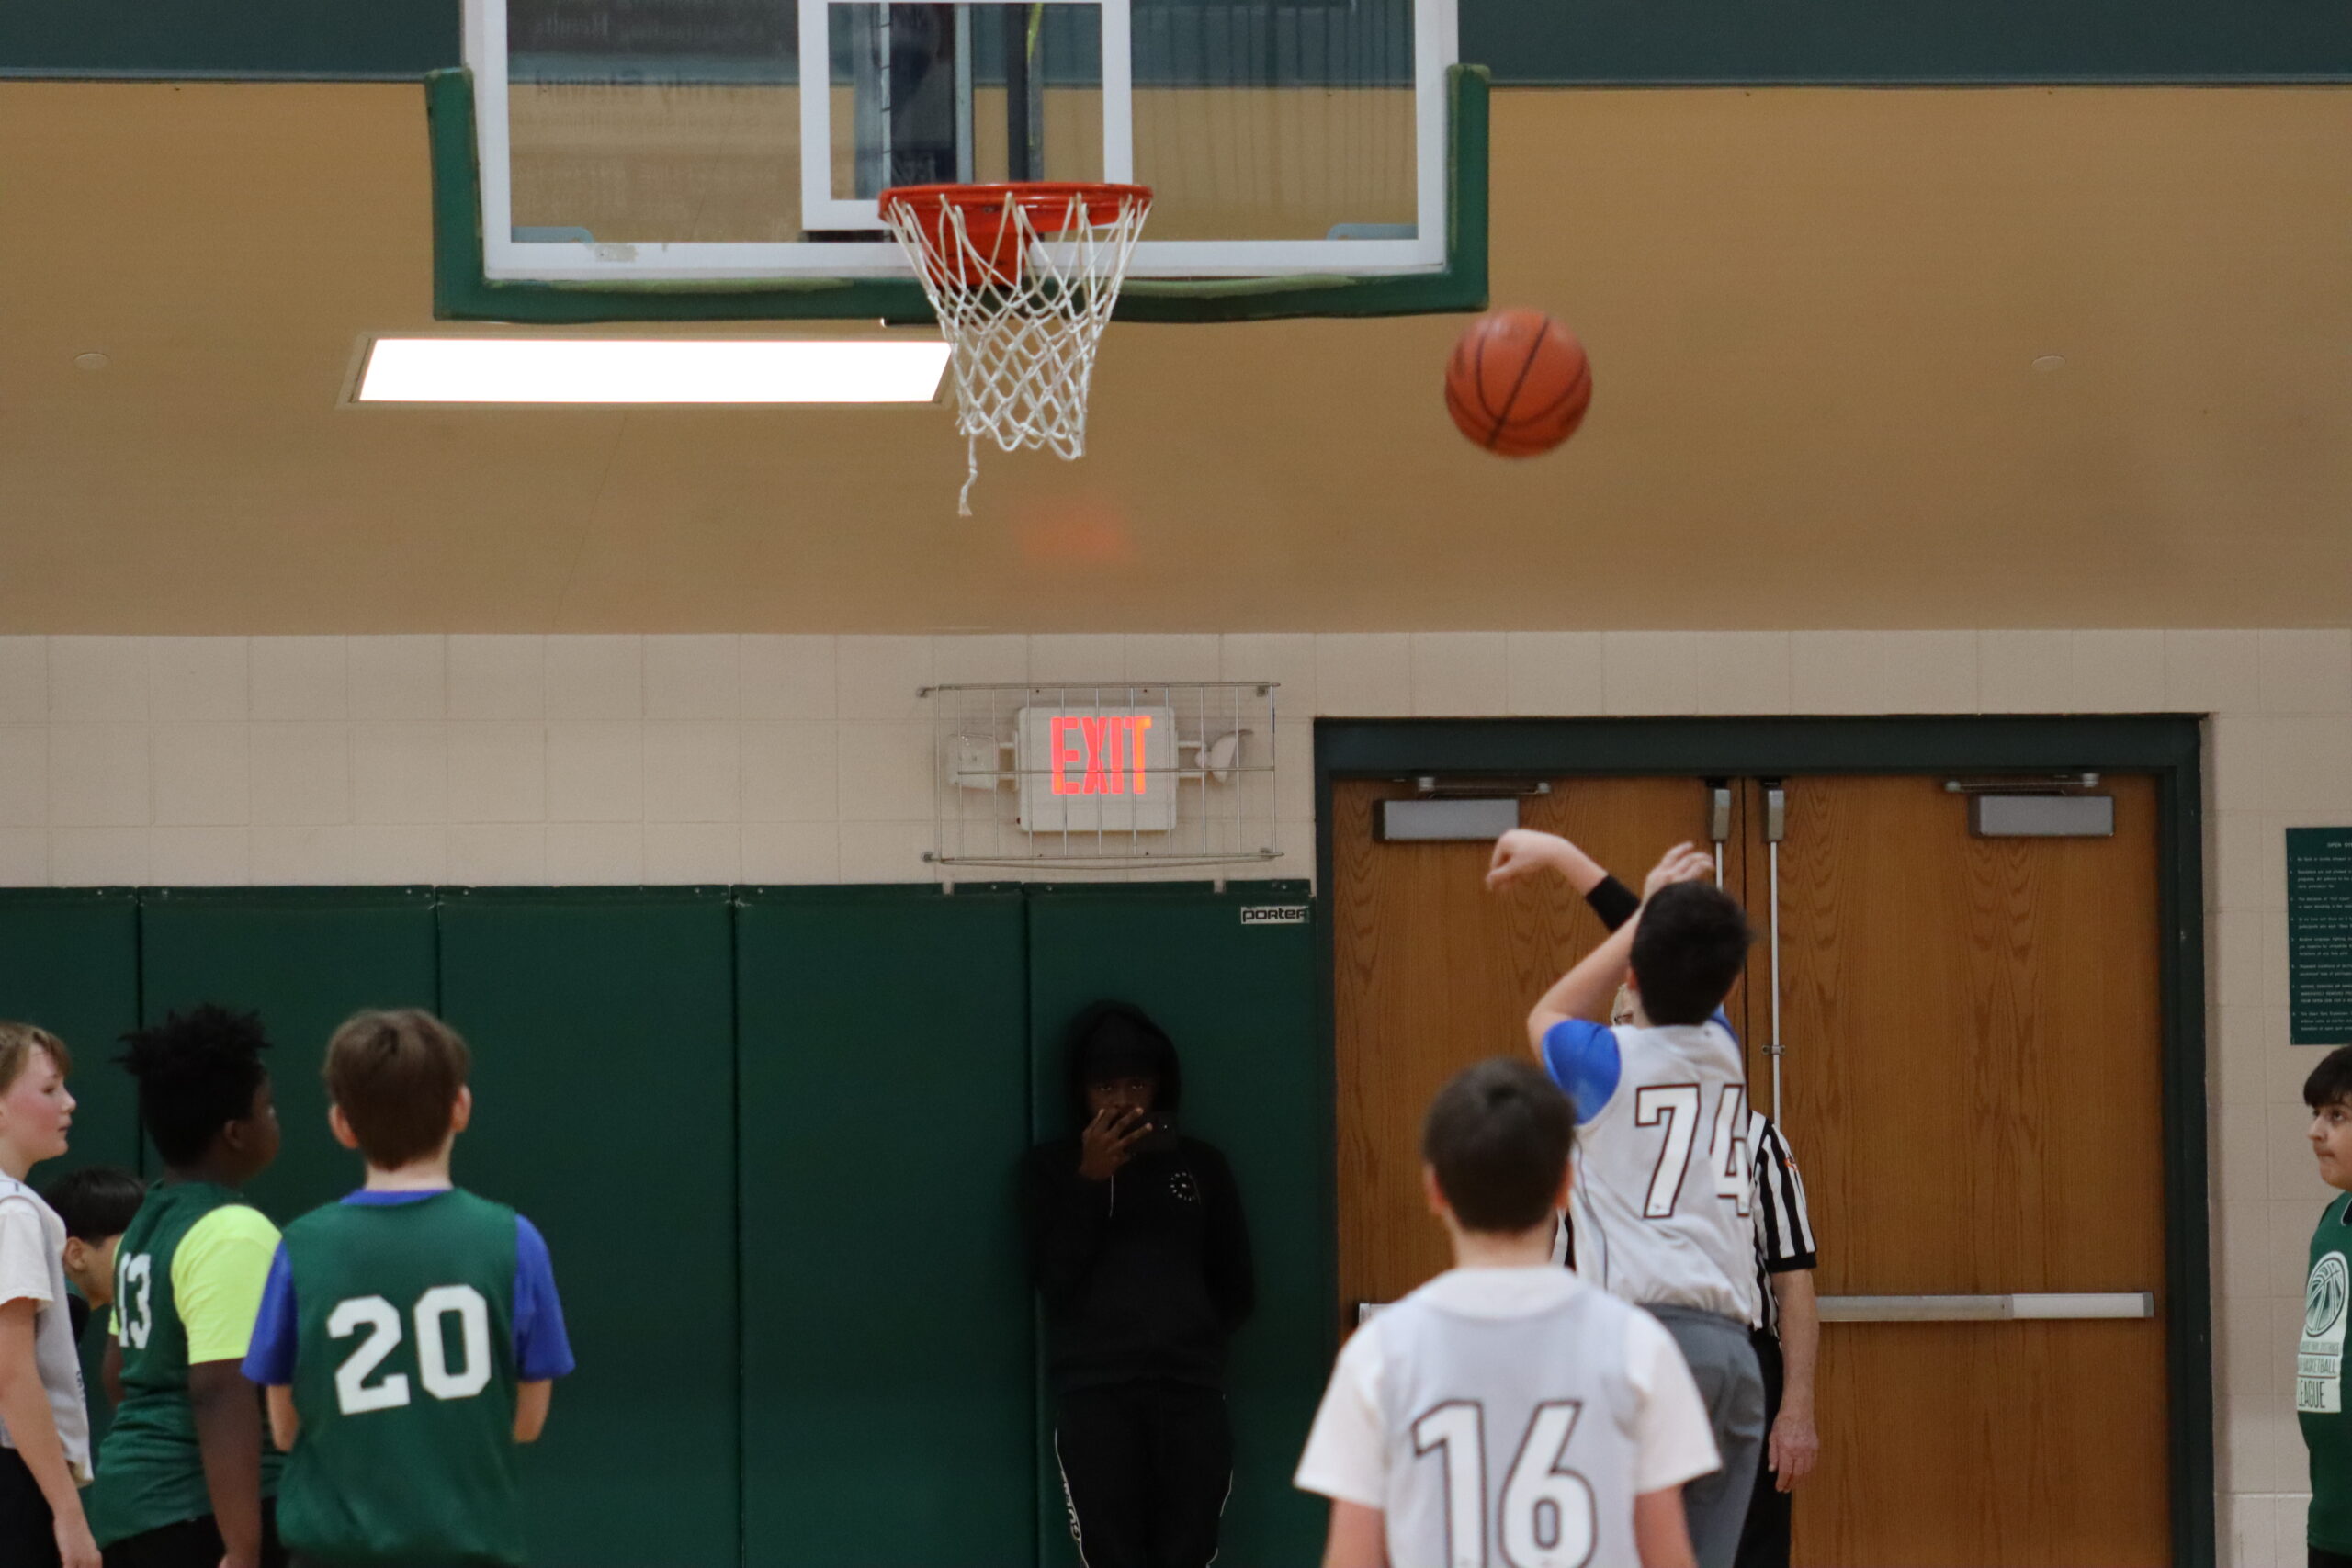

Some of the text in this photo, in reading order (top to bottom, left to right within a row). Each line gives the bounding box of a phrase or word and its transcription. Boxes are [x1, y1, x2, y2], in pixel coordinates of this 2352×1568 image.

[1051, 716, 1152, 795] EXIT
[1634, 1082, 1751, 1219] 74
[118, 1251, 152, 1349] 13
[326, 1283, 492, 1415] 20
[1409, 1398, 1599, 1568] 16
